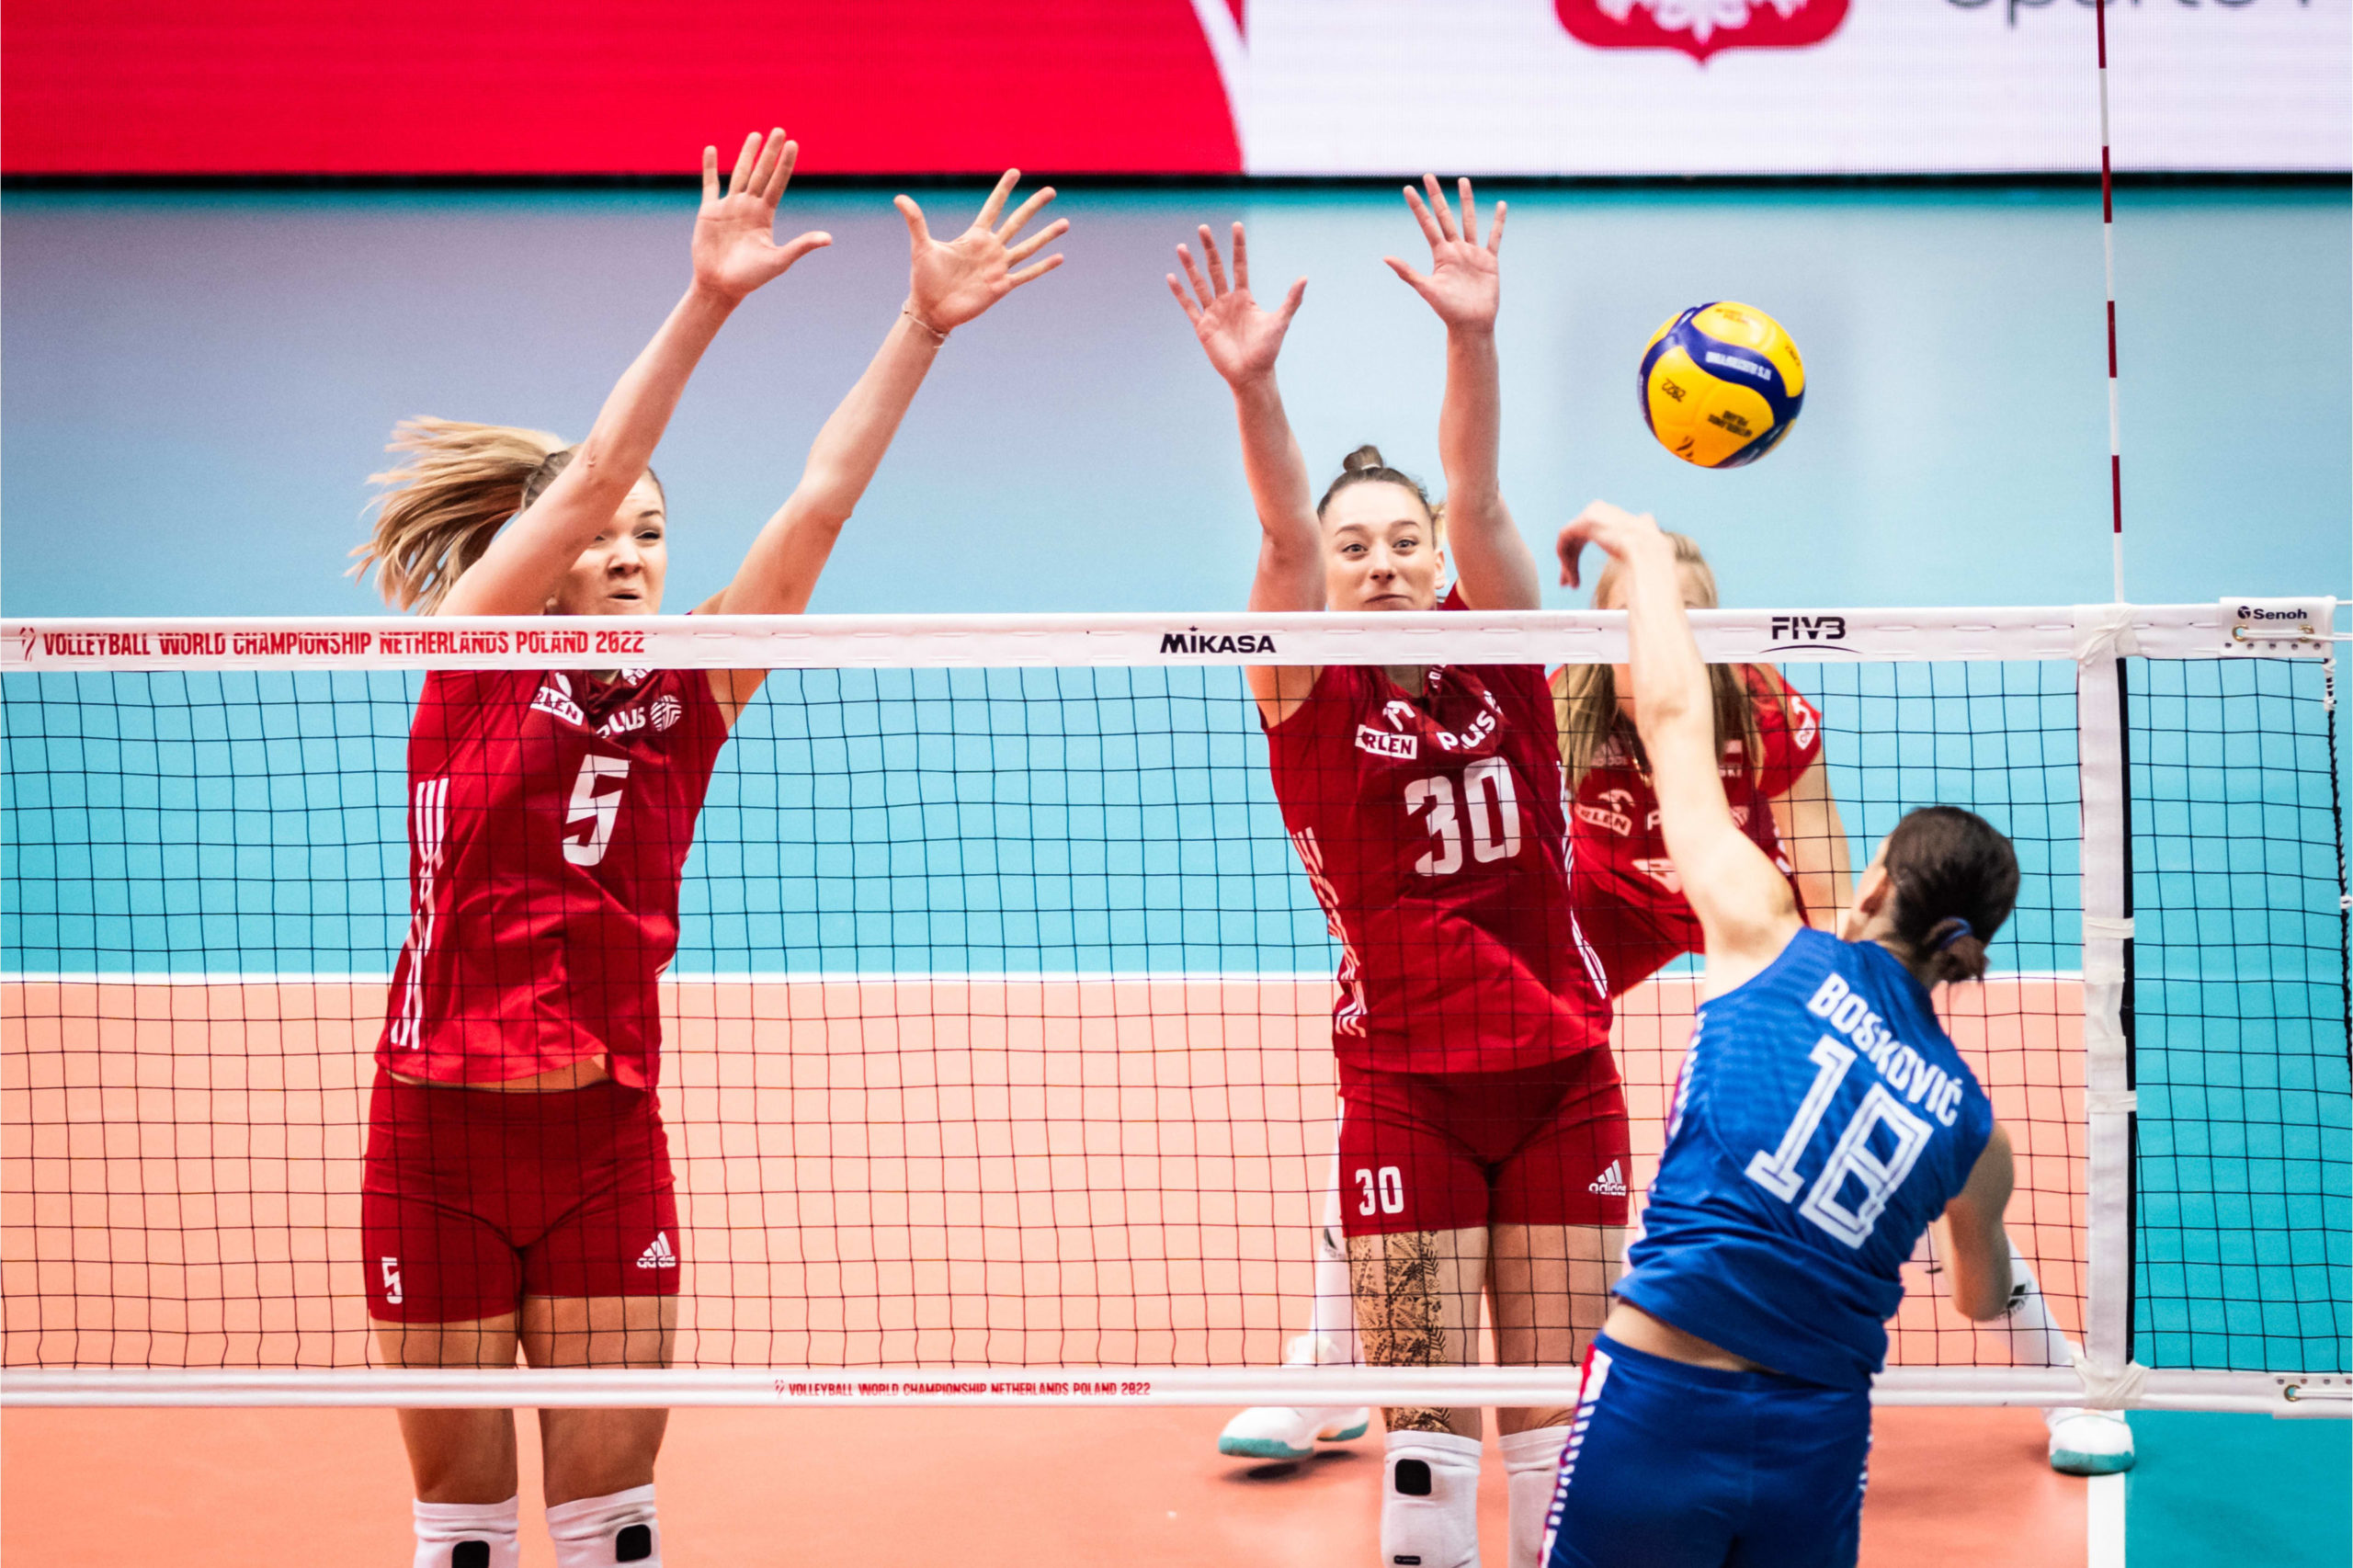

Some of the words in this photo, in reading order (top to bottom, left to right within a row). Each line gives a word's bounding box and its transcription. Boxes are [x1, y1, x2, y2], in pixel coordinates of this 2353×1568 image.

[2253, 608, 2308, 620] Senoh
[1160, 626, 1278, 653] MIKASA
[1771, 616, 1846, 641] FIVB
[43, 632, 151, 656] VOLLEYBALL
[157, 632, 226, 656] WORLD
[233, 631, 372, 656] CHAMPIONSHIP
[379, 631, 508, 655] NETHERLANDS
[516, 631, 588, 654] POLAND
[596, 631, 645, 654] 2022
[562, 753, 632, 867] 5
[1404, 756, 1521, 877] 30
[1744, 1033, 1935, 1250] 18
[1355, 1165, 1404, 1216] 30
[1588, 1180, 1627, 1197] adidas
[381, 1256, 403, 1304] 5
[789, 1383, 854, 1396] VOLLEYBALL
[858, 1383, 899, 1396] WORLD
[903, 1382, 987, 1396] CHAMPIONSHIP
[991, 1382, 1069, 1396] NETHERLANDS
[1074, 1382, 1118, 1396] POLAND
[1120, 1382, 1151, 1396] 2022
